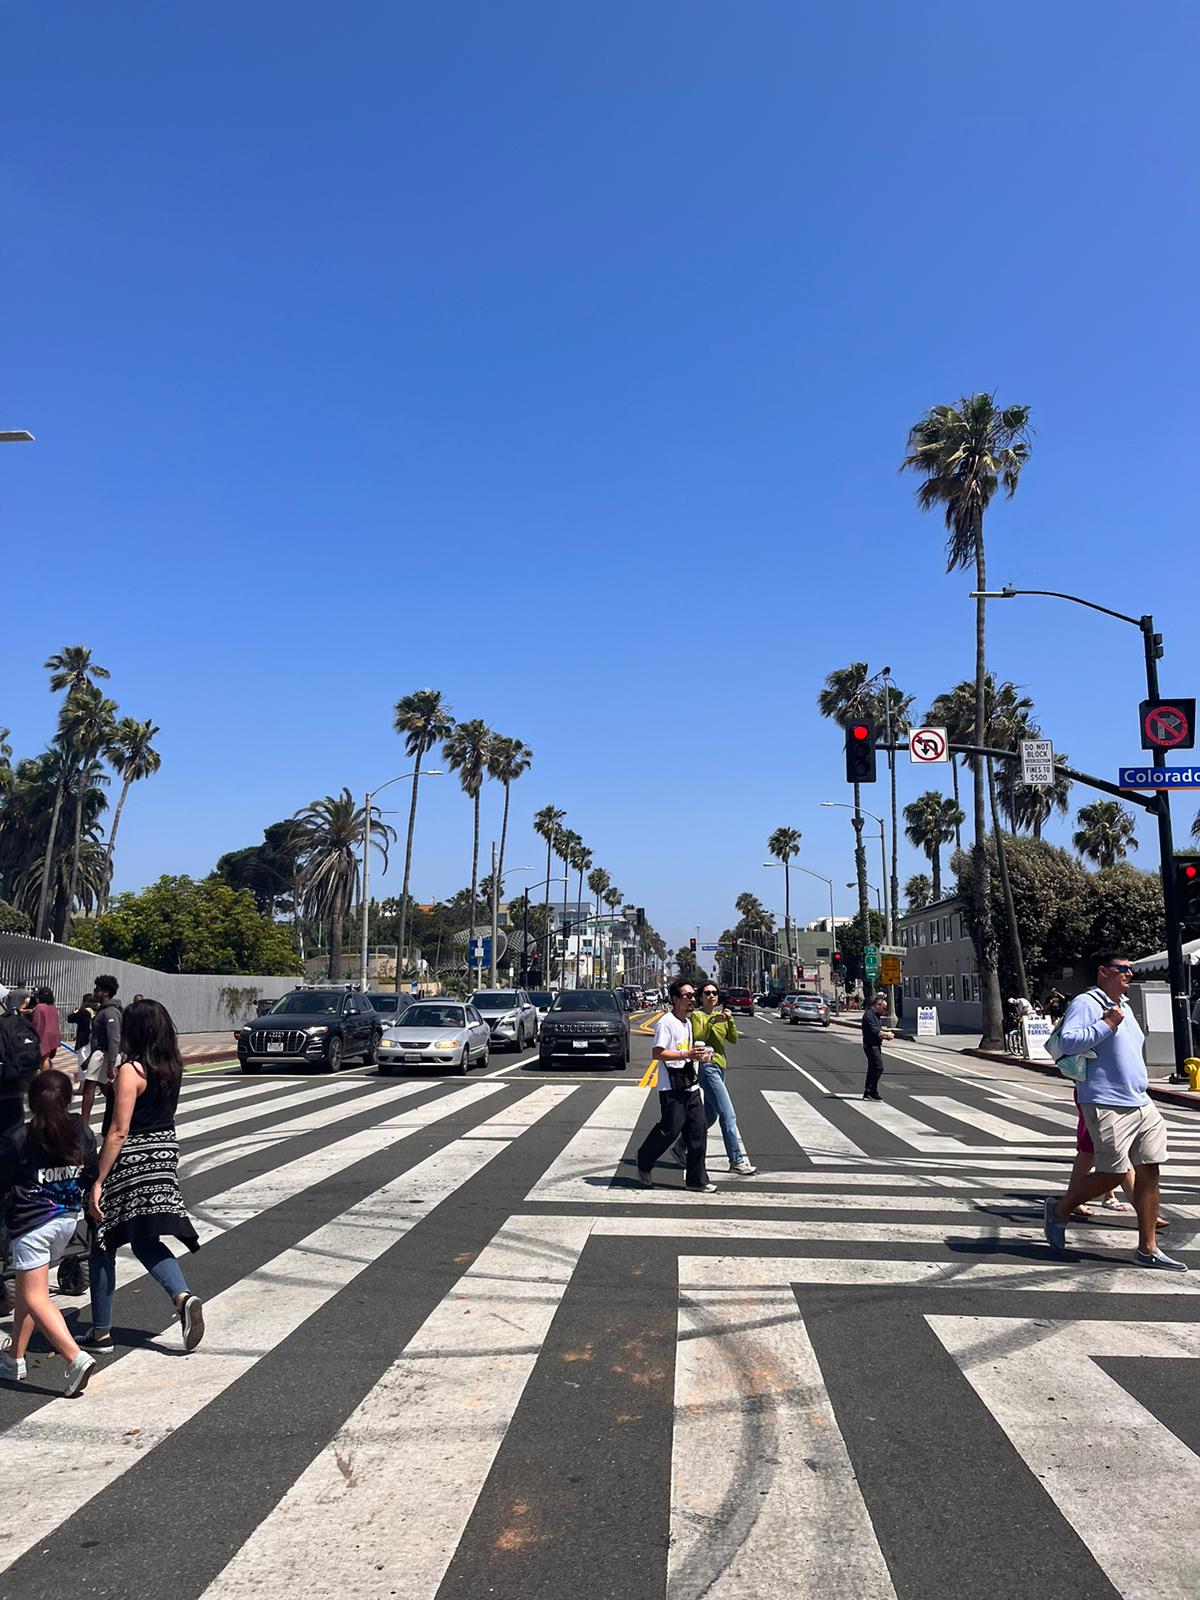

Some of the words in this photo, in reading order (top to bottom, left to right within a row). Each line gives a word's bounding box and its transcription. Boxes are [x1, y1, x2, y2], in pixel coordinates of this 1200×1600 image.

[1024, 743, 1034, 751] DO
[1036, 743, 1049, 751] NOT
[1030, 773, 1048, 781] $500
[1124, 769, 1200, 783] Colorado
[37, 1164, 85, 1184] FORTNTE
